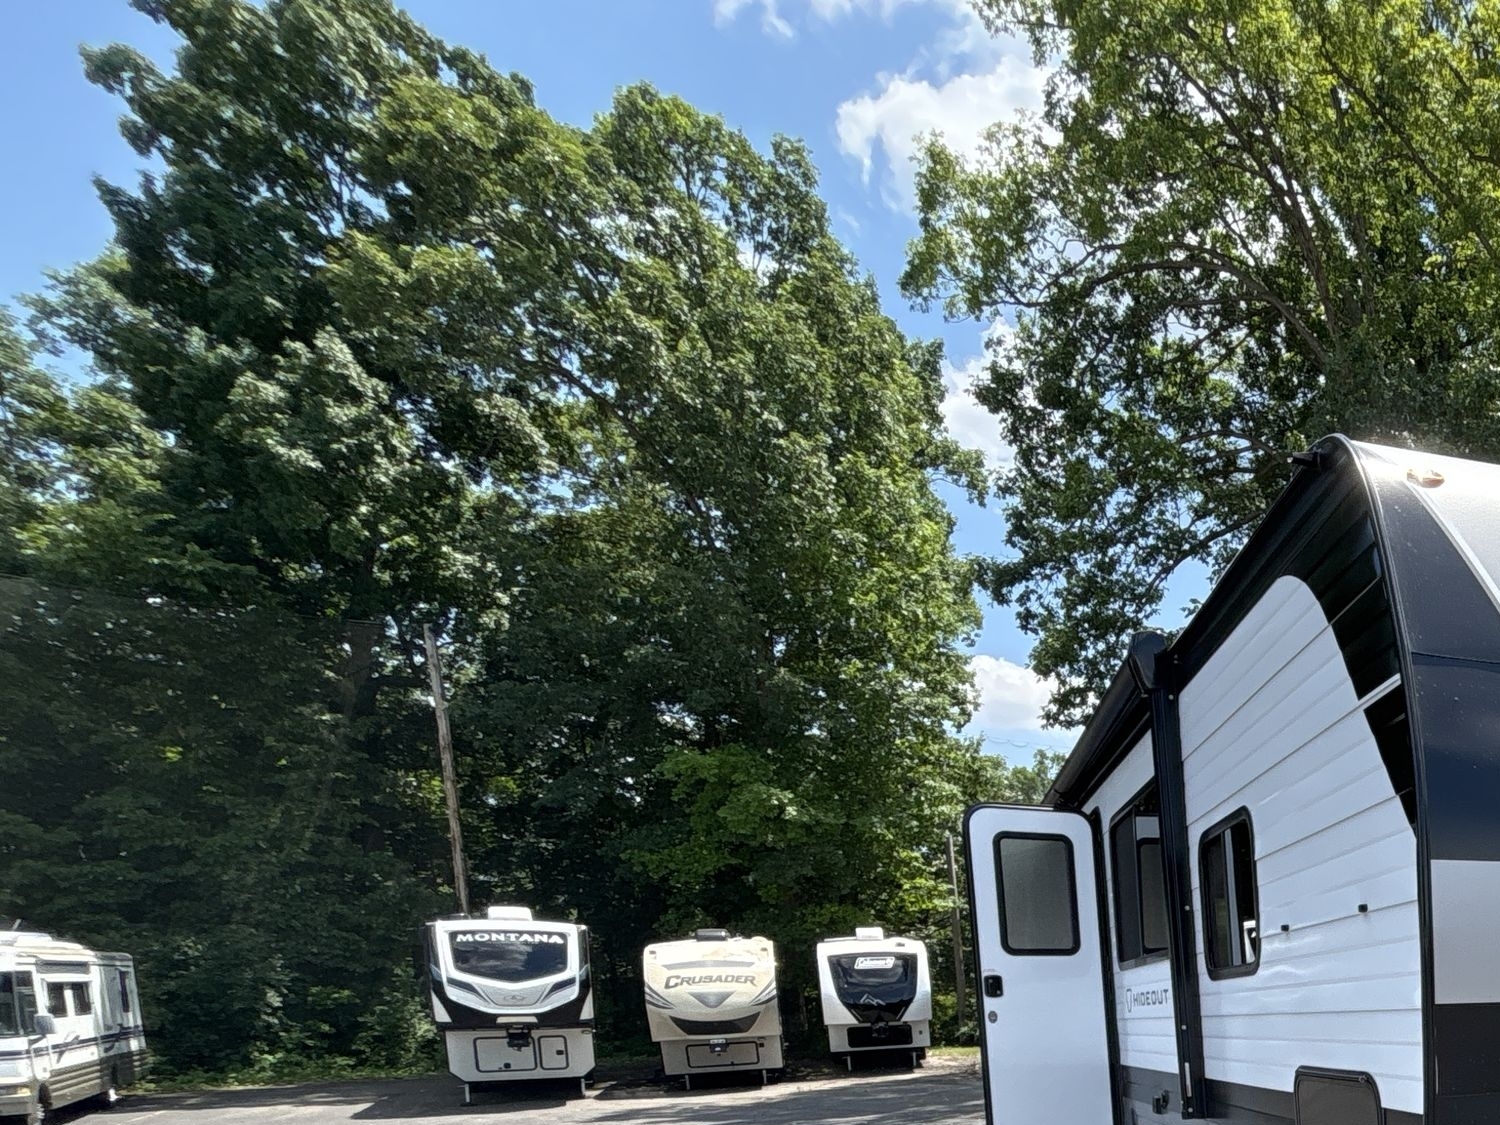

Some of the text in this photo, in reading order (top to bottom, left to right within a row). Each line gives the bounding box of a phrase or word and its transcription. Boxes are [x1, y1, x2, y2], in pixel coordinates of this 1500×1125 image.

[456, 932, 565, 944] MONTANA
[664, 974, 758, 990] CRUSADER
[1132, 988, 1169, 1007] HIDEOUT
